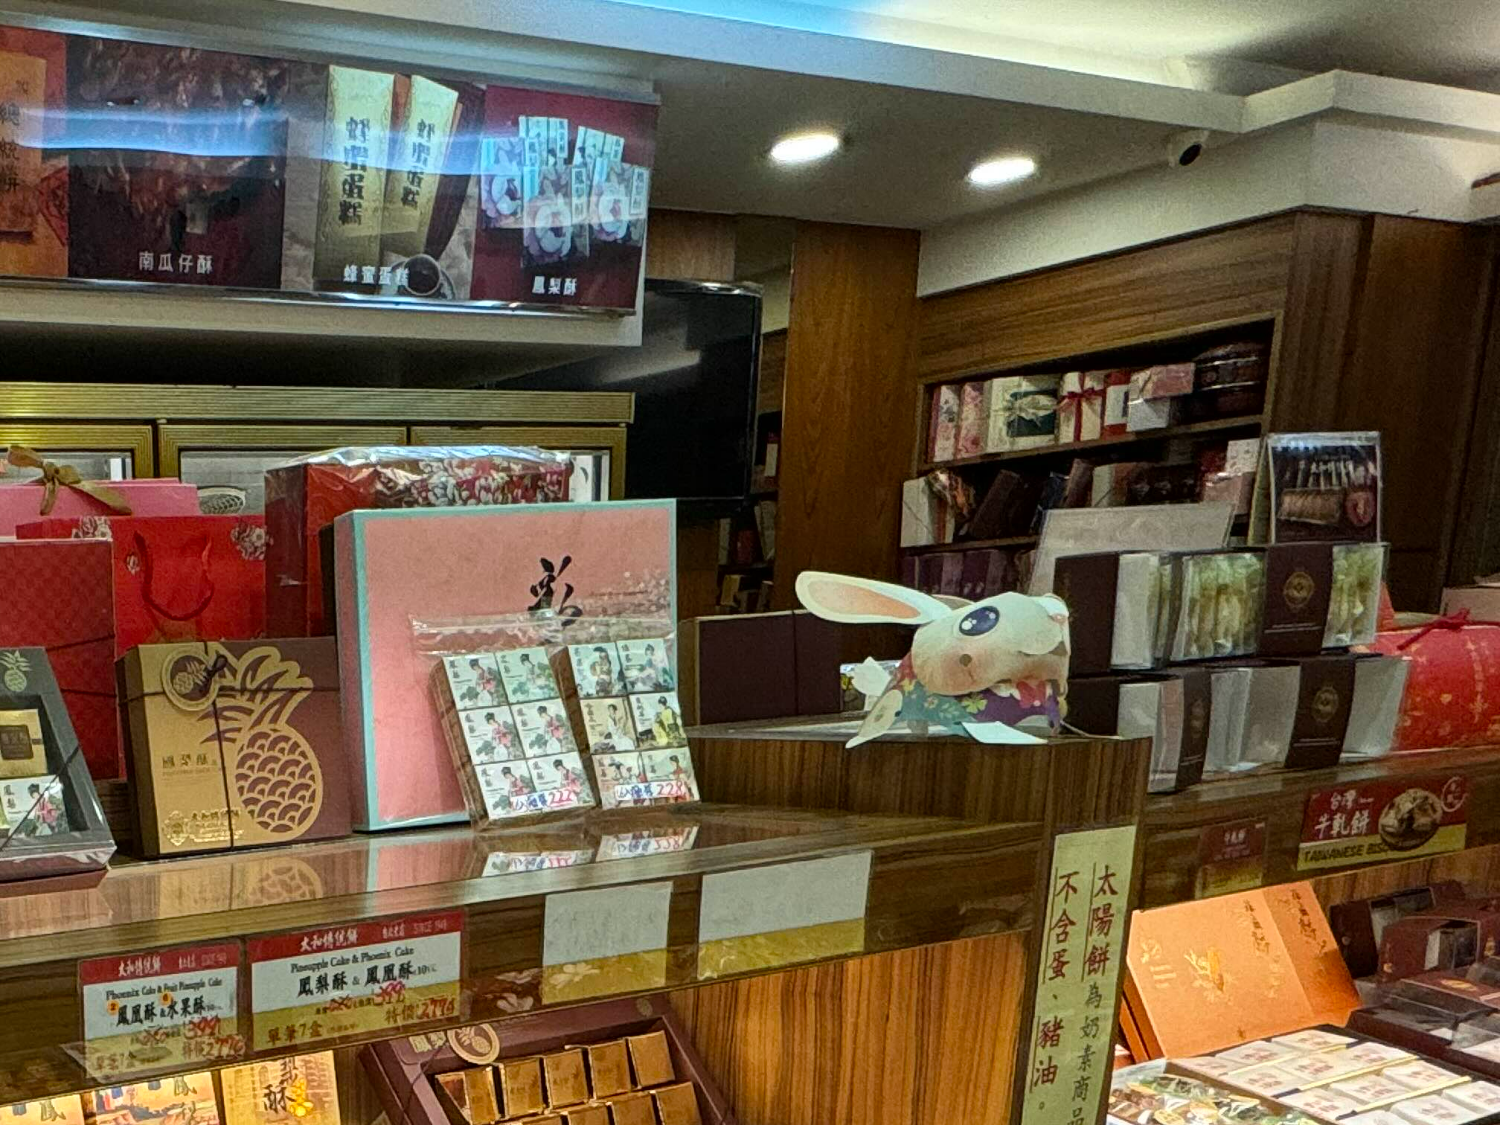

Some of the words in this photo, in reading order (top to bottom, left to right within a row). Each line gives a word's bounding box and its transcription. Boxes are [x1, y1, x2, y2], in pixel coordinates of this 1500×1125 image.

[139, 252, 213, 275] 南瓜仔酥
[532, 275, 577, 296] 鳳梨酥
[1314, 809, 1371, 839] 牛軋餅
[291, 959, 329, 975] Pineapple
[330, 955, 350, 967] Cake
[361, 950, 391, 963] Phoenix
[394, 946, 415, 957] Cake
[106, 988, 140, 1001] Phoenix
[142, 985, 157, 996] Cake
[297, 970, 349, 998] 鳳梨酥
[364, 960, 414, 988] 鳳凰酥
[116, 1001, 159, 1027] 鳳凰酥
[166, 995, 206, 1020] 水果酥
